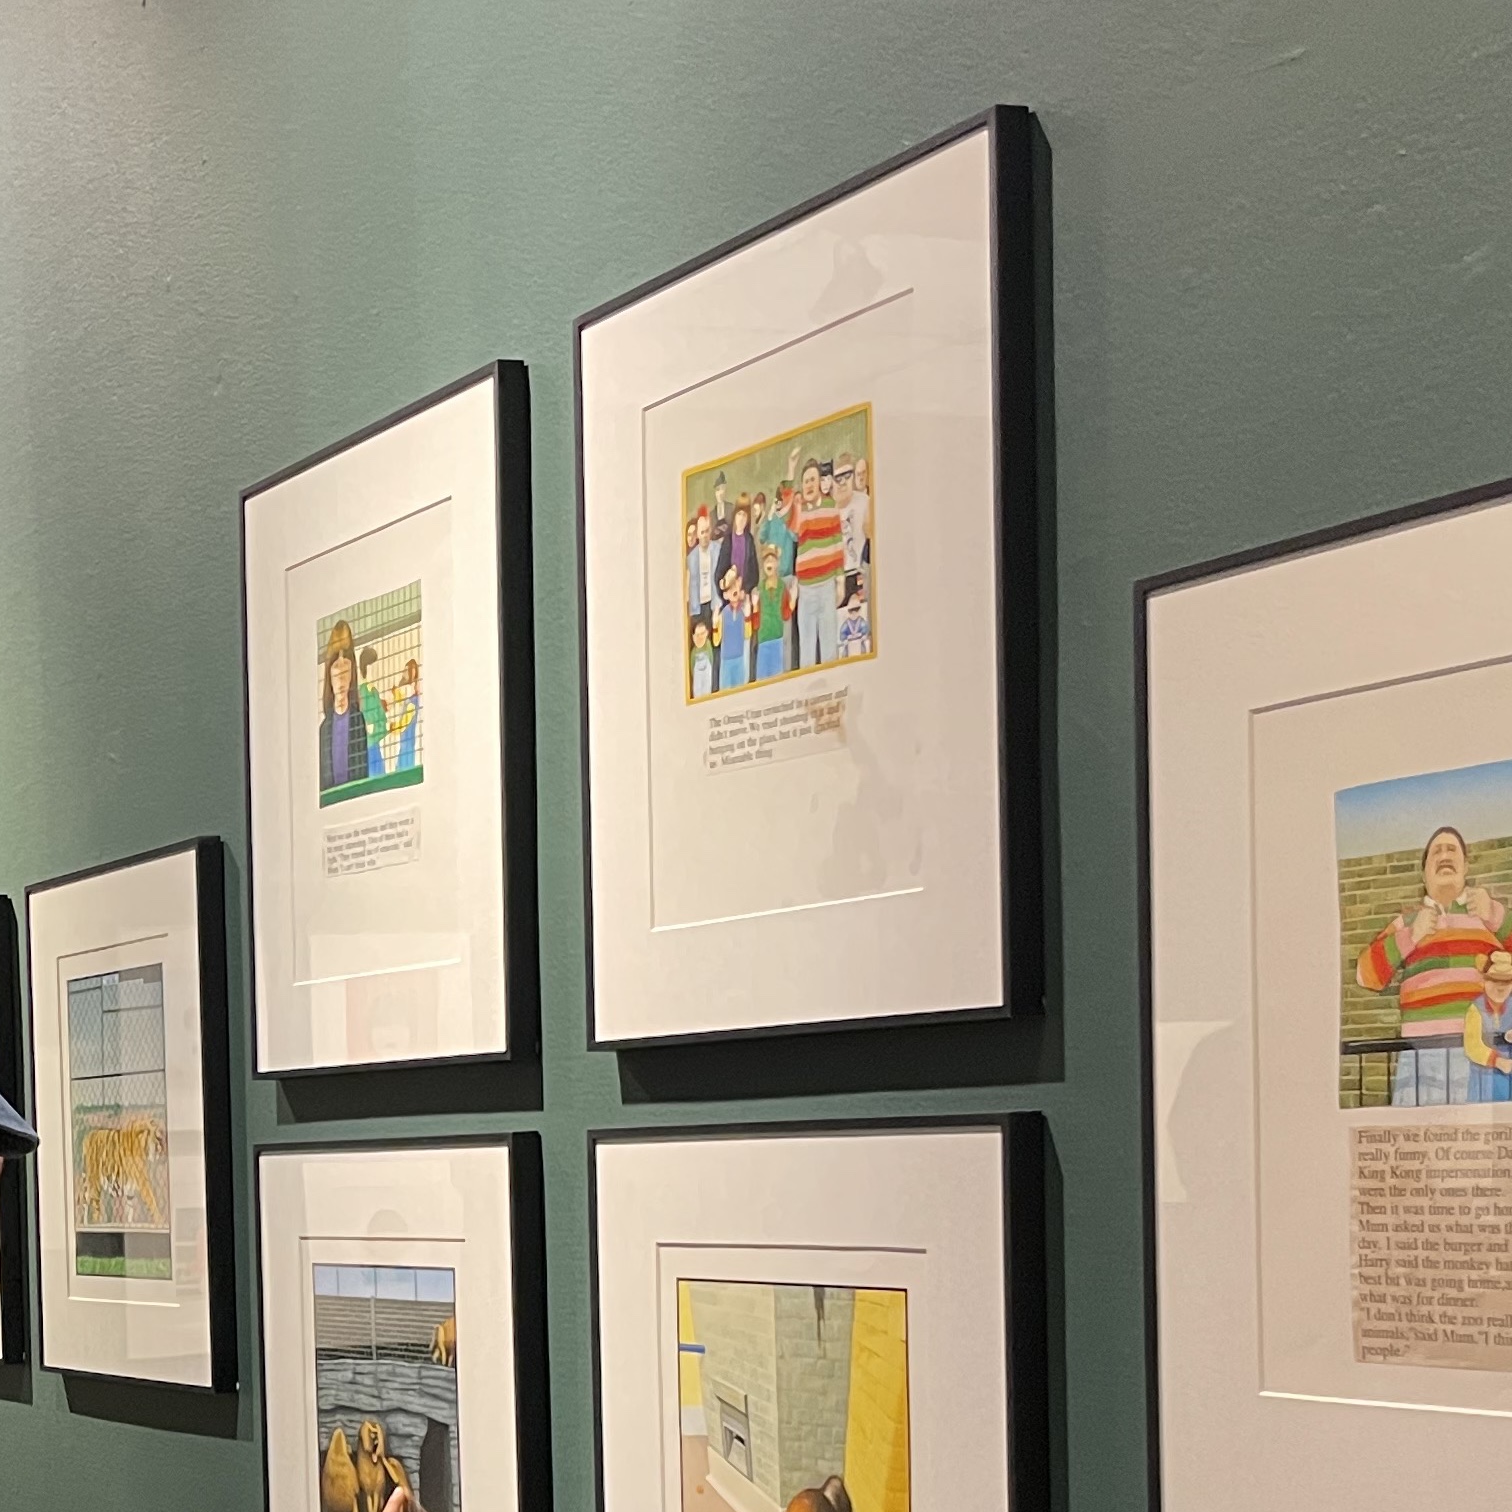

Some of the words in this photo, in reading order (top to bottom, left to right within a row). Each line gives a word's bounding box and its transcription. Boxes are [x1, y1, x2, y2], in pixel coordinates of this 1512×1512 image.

[1358, 1129, 1400, 1147] Finally
[1403, 1132, 1420, 1143] we
[1424, 1127, 1458, 1143] found
[1461, 1127, 1480, 1142] the
[1358, 1148, 1390, 1165] really
[1435, 1146, 1452, 1161] Of
[1454, 1150, 1494, 1161] course
[1358, 1165, 1386, 1183] King
[1390, 1165, 1422, 1183] Kong
[1359, 1187, 1386, 1198] were
[1389, 1184, 1407, 1197] the
[1410, 1184, 1436, 1201] only
[1439, 1187, 1467, 1197] ones
[1358, 1201, 1386, 1215] Then
[1391, 1204, 1399, 1216] it
[1403, 1205, 1425, 1215] was
[1429, 1204, 1456, 1216] time
[1459, 1204, 1471, 1216] to
[1474, 1206, 1490, 1219] go
[1358, 1219, 1388, 1233] Mum
[1392, 1219, 1424, 1233] asked
[1428, 1223, 1441, 1233] us
[1445, 1220, 1473, 1235] what
[1477, 1224, 1501, 1235] was
[1386, 1236, 1391, 1250] I
[1394, 1237, 1419, 1251] said
[1421, 1238, 1440, 1251] the
[1443, 1238, 1482, 1255] burger
[1486, 1239, 1509, 1253] and
[1358, 1253, 1392, 1269] Harry
[1394, 1254, 1419, 1268] said
[1421, 1256, 1440, 1269] the
[1443, 1257, 1492, 1274] monkey
[1358, 1271, 1382, 1286] best
[1403, 1275, 1427, 1288] was
[1430, 1277, 1465, 1293] going
[1359, 1290, 1387, 1304] what
[1390, 1294, 1413, 1305] was
[1416, 1291, 1435, 1306] for
[1373, 1307, 1403, 1322] don't
[1405, 1309, 1437, 1324] think
[1439, 1310, 1458, 1325] the
[1461, 1315, 1484, 1326] zoo
